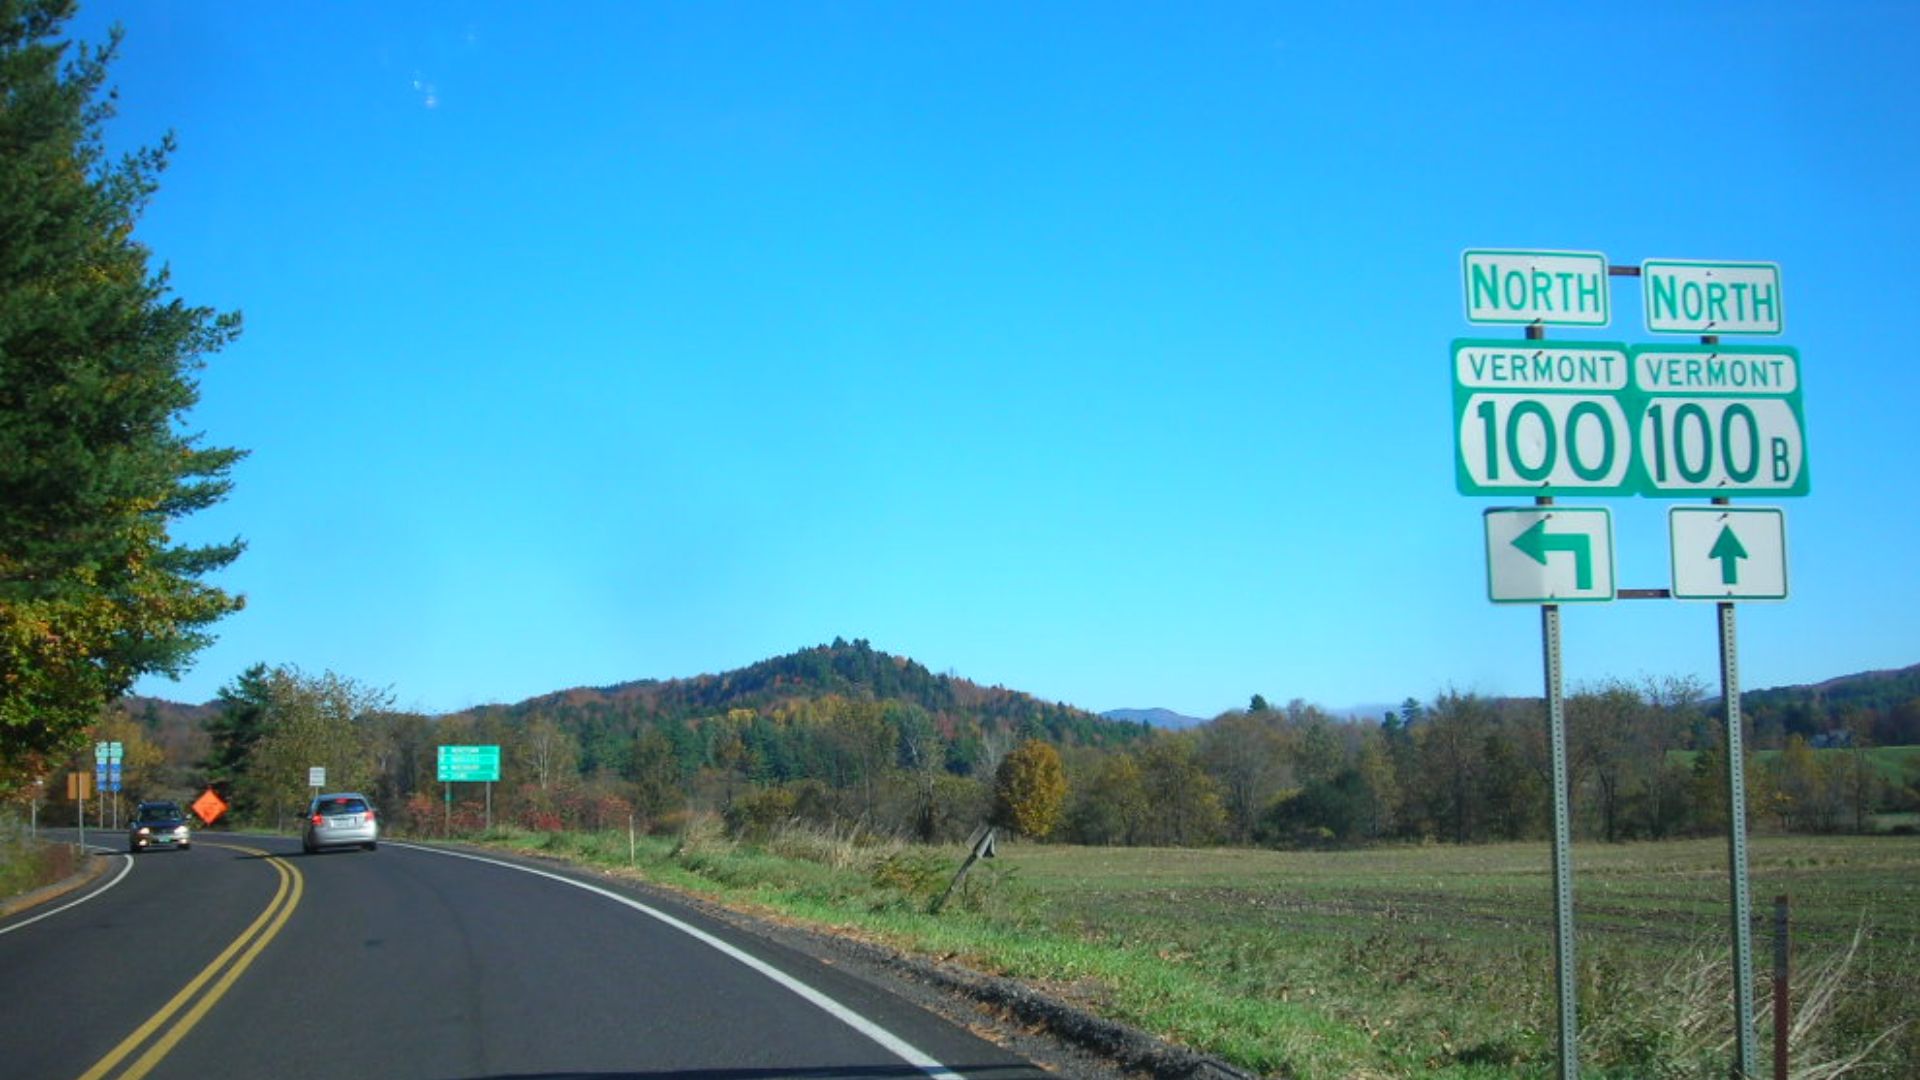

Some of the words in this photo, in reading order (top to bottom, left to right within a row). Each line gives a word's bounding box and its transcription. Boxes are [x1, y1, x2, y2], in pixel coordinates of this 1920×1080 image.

[1472, 264, 1600, 312] NORTH
[1652, 275, 1775, 322] NORTH
[1468, 354, 1615, 383] VERMONT
[1645, 358, 1784, 387] VERMONT
[1477, 400, 1616, 481] 100
